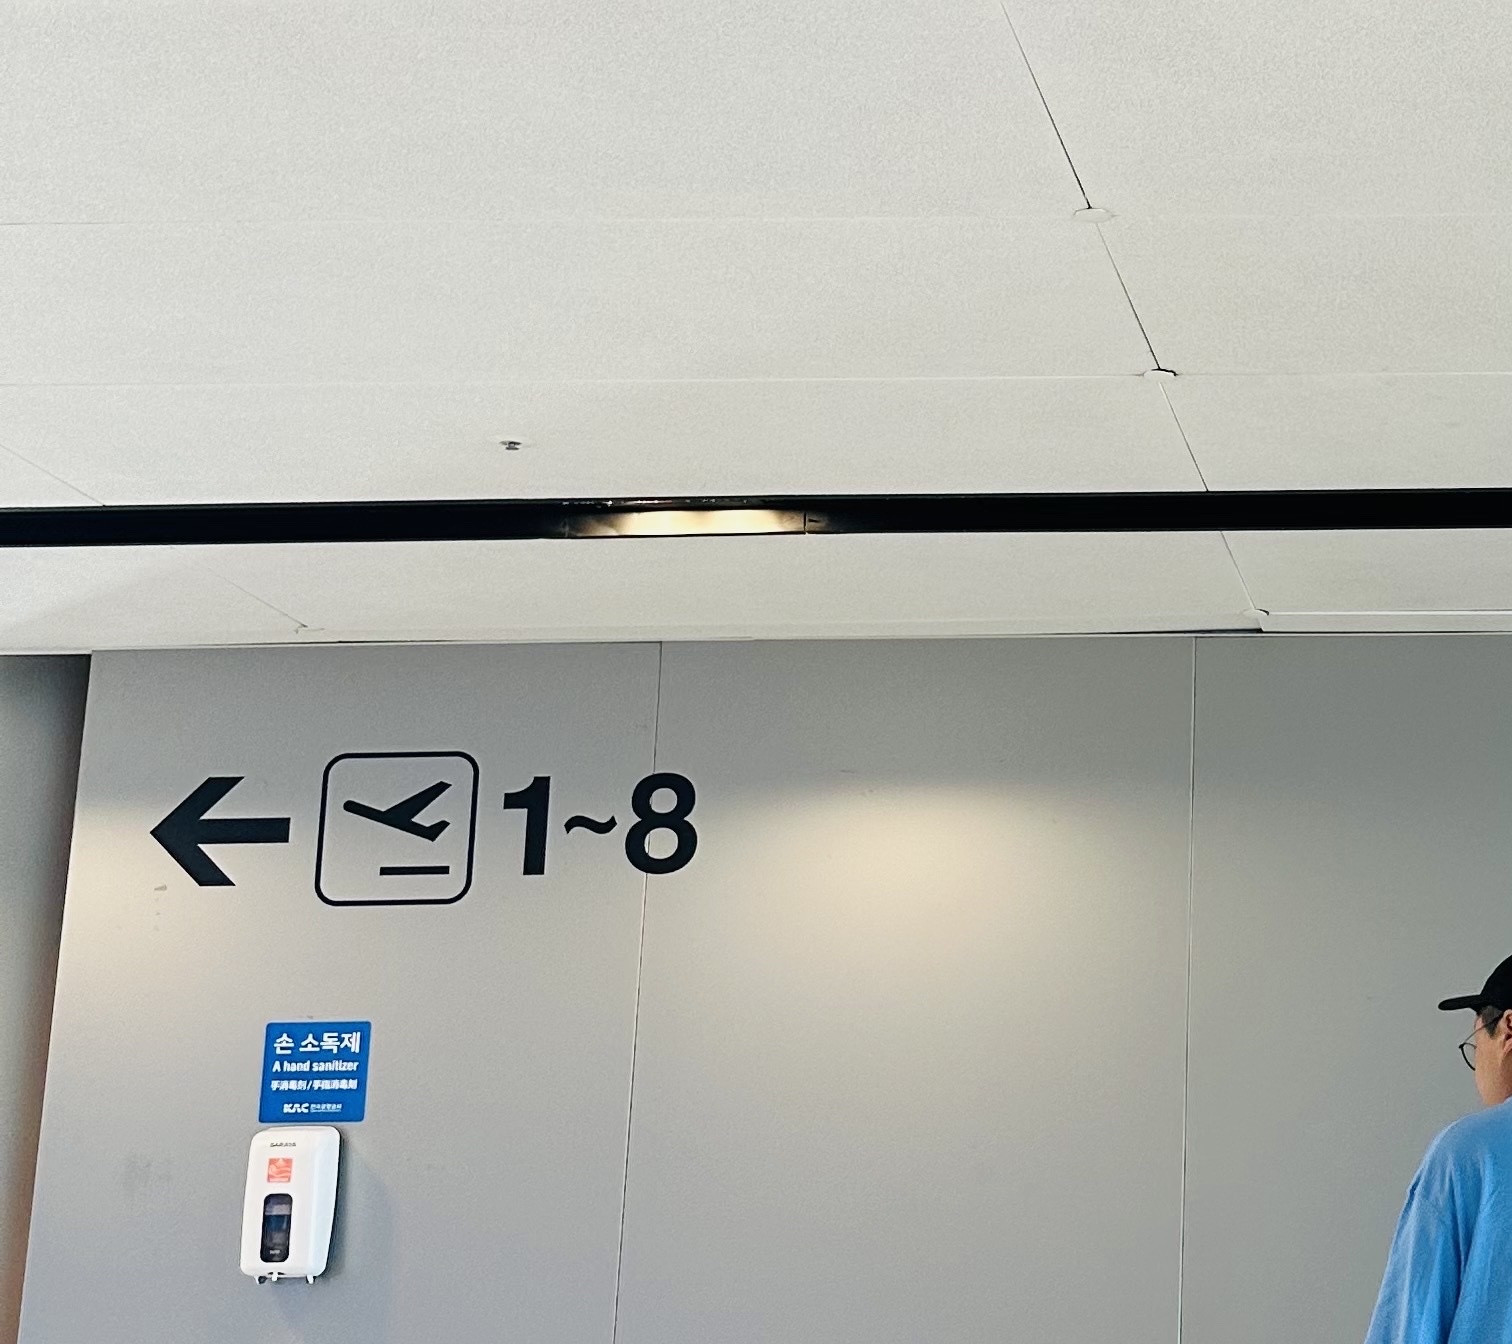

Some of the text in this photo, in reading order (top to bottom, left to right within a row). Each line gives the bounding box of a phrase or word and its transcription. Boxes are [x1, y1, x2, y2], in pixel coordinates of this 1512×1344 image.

[503, 772, 698, 875] 1~8
[273, 1031, 361, 1055] 손 소독제
[272, 1060, 360, 1072] A hand sanitizer
